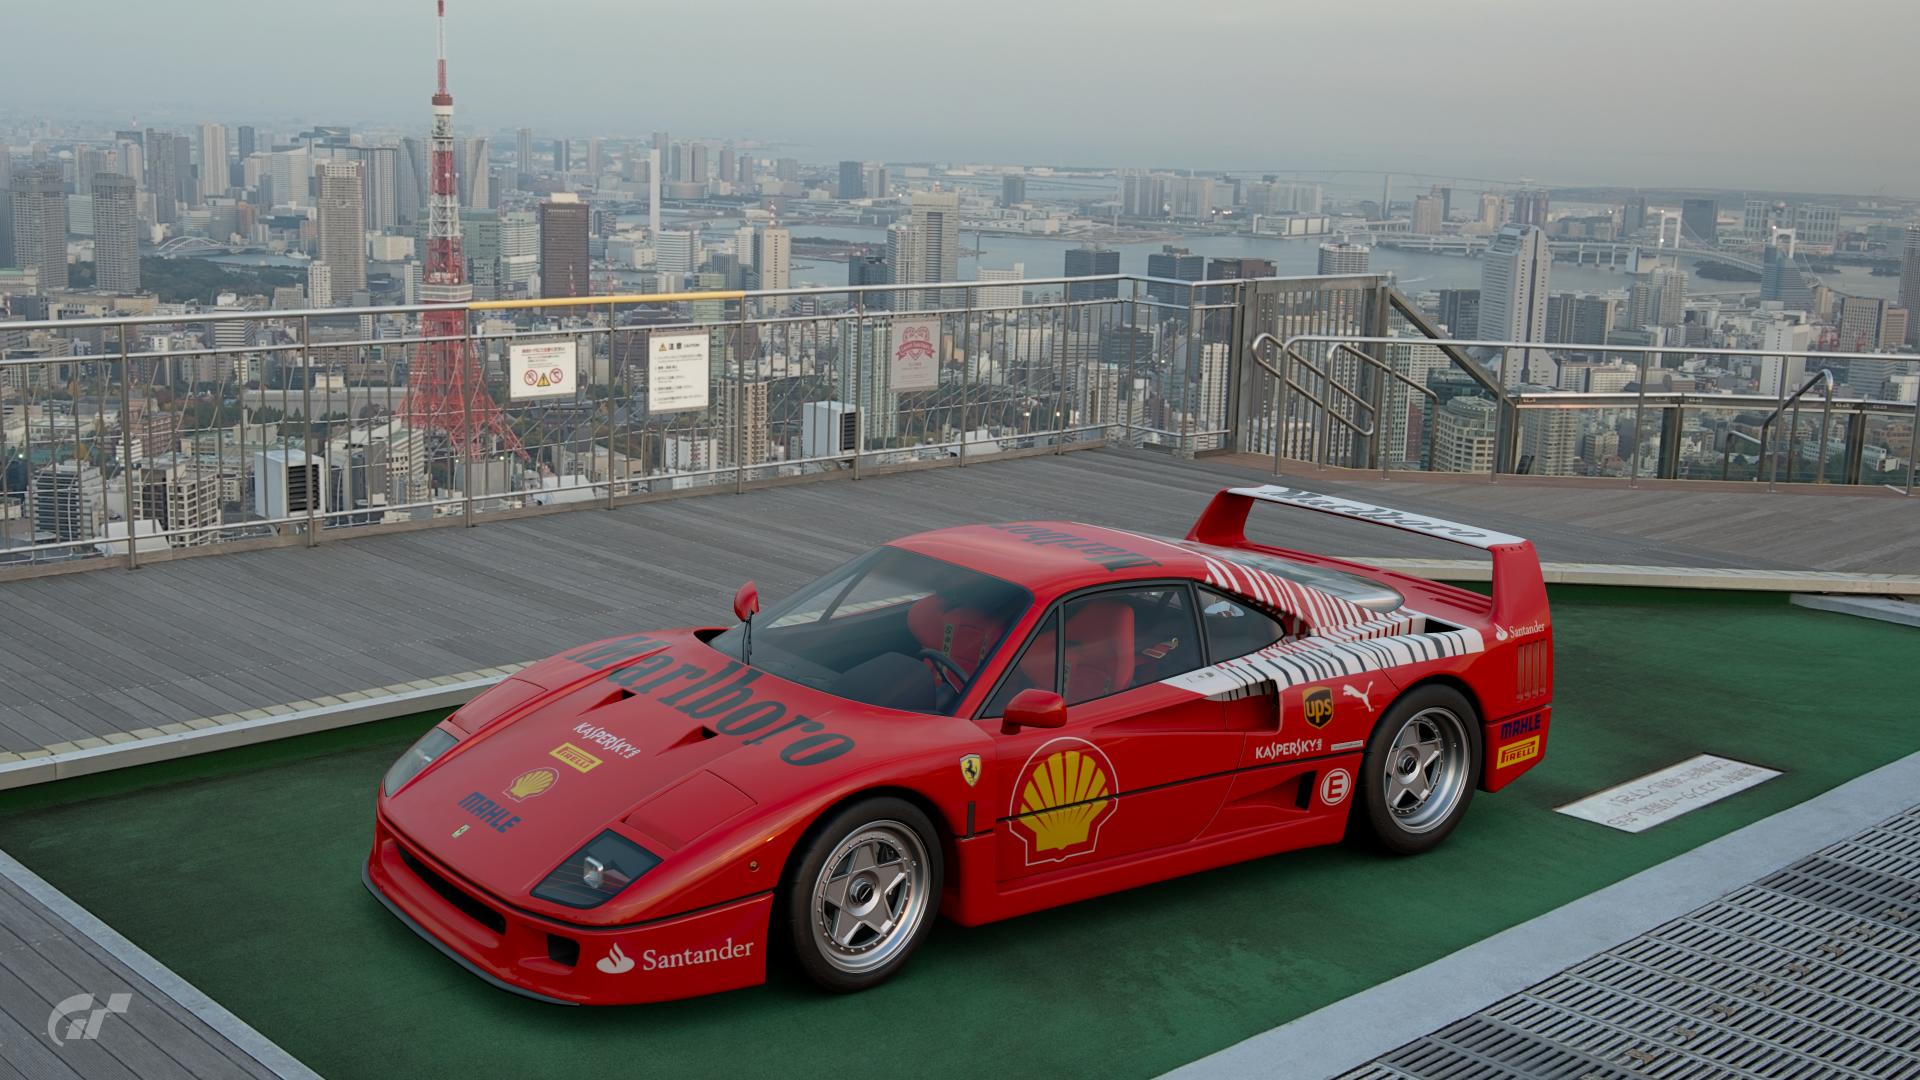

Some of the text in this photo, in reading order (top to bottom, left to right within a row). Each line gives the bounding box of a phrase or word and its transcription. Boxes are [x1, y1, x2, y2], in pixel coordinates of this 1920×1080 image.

[1509, 620, 1545, 639] Santander
[563, 636, 856, 767] Marlboro
[1305, 699, 1333, 723] ups
[573, 722, 636, 757] KASPERSKY
[1500, 713, 1541, 741] MAHLE
[558, 747, 595, 769] PIRELLI
[1255, 738, 1317, 760] KASPERSKY
[1501, 741, 1536, 764] PIRELLI
[457, 791, 522, 833] MAHLE
[642, 939, 754, 972] Santander
